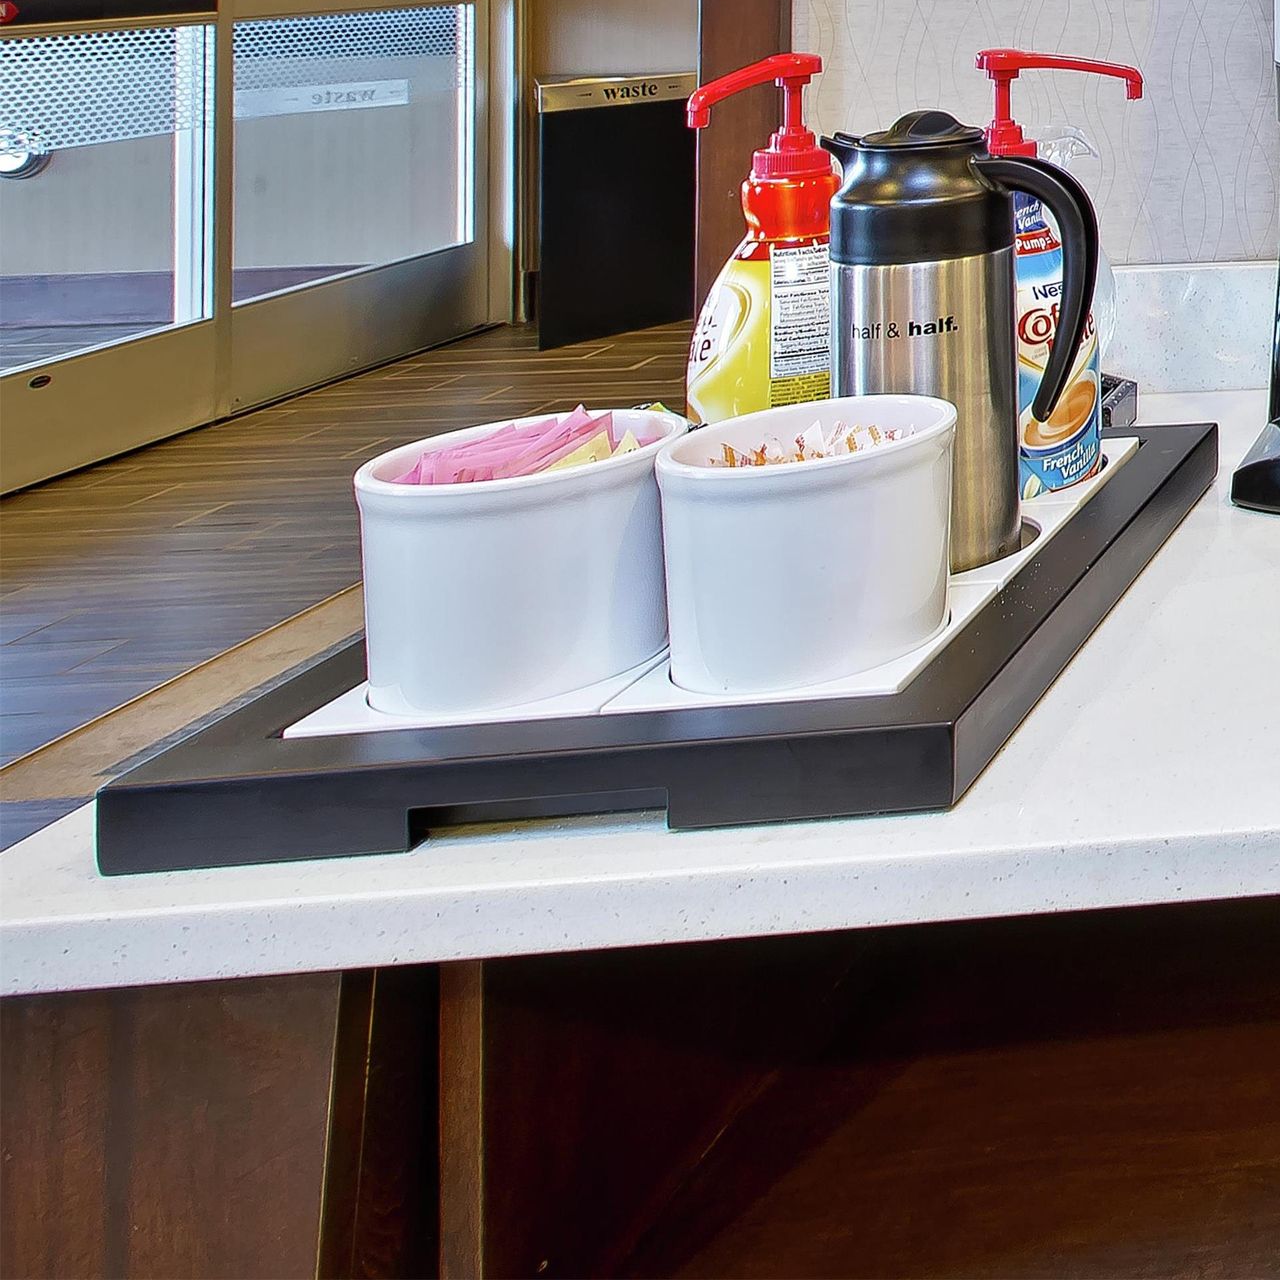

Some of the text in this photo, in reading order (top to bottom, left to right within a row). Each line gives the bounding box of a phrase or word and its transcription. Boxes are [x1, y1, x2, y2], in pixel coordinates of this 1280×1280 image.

[603, 80, 658, 100] waste
[1032, 281, 1063, 300] Nes
[852, 316, 958, 339] half & half.
[1043, 442, 1084, 472] French
[1060, 442, 1096, 479] Vanilla
